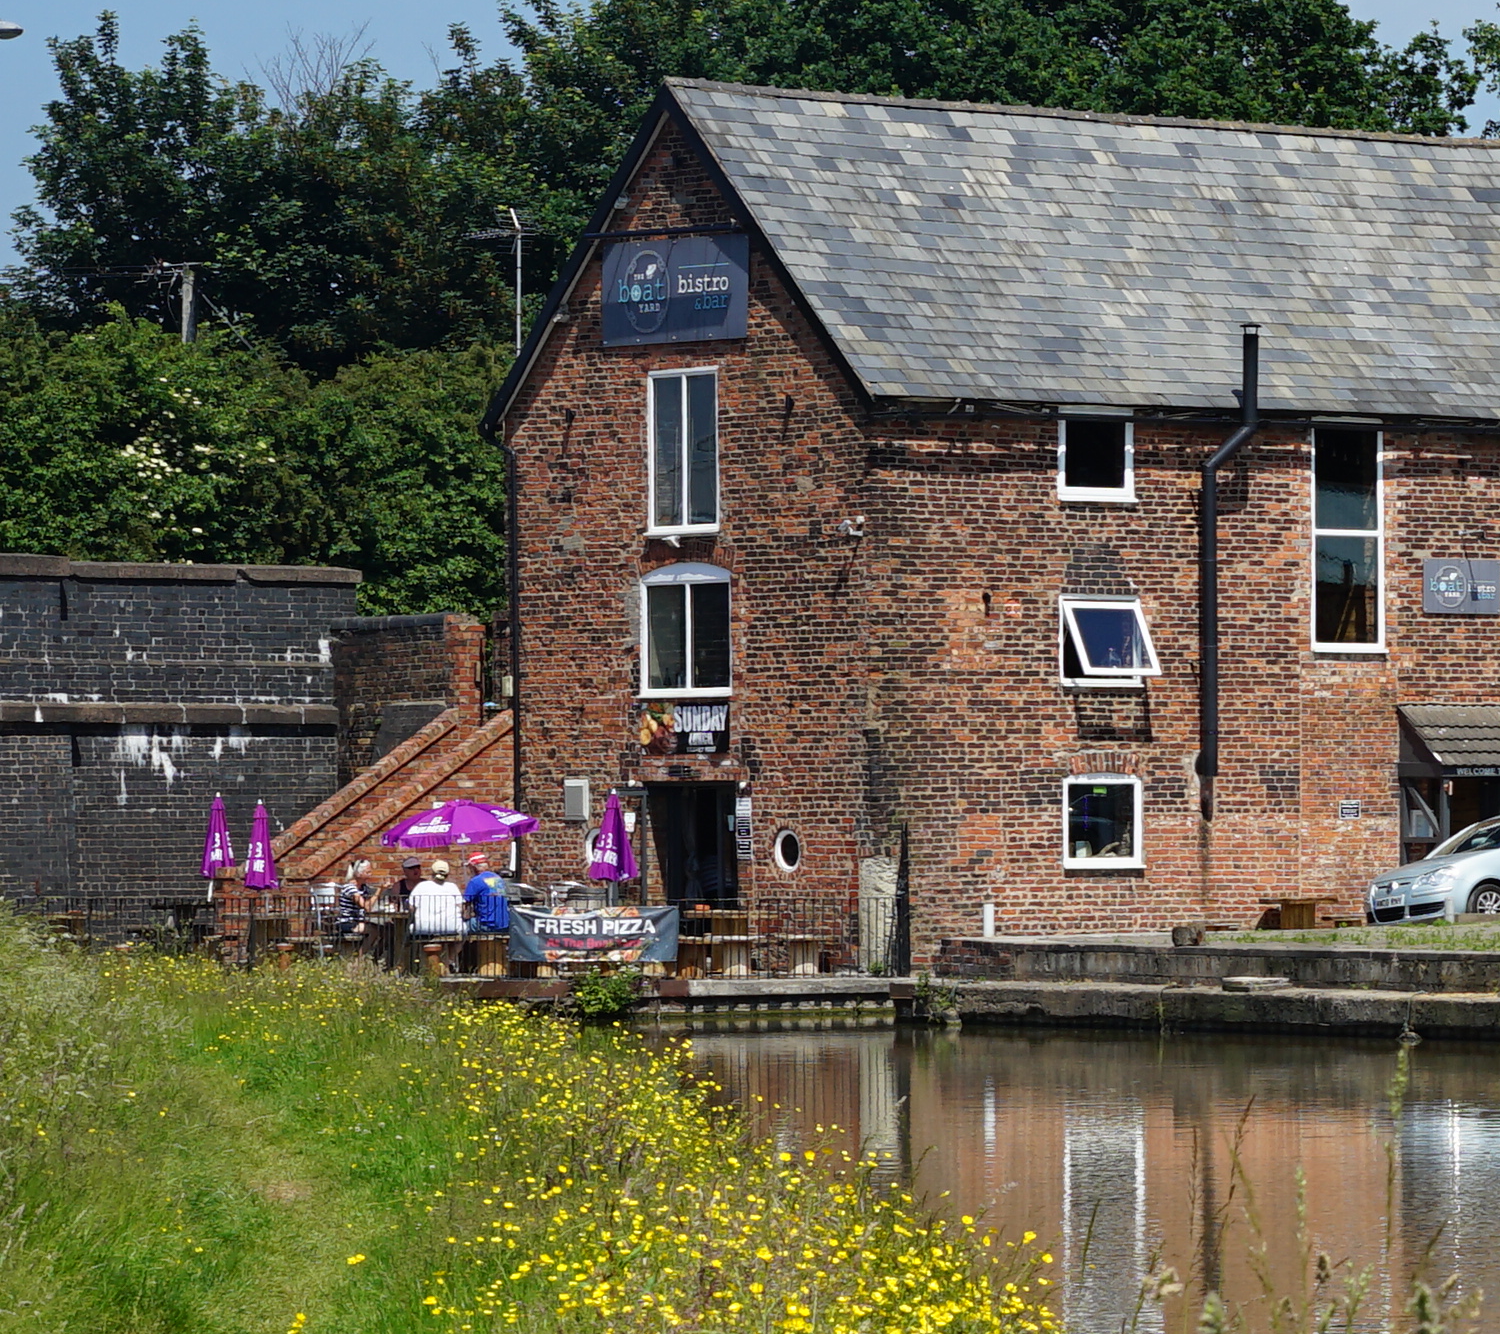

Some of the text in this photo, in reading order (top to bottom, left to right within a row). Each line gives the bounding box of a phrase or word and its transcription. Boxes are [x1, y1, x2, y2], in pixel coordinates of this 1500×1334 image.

[618, 279, 666, 303] boat
[677, 274, 729, 293] bistro
[639, 303, 661, 313] YARD
[673, 705, 728, 732] SUNDAY
[1456, 767, 1496, 775] WELCOME
[534, 919, 656, 935] FRESH PIZZA
